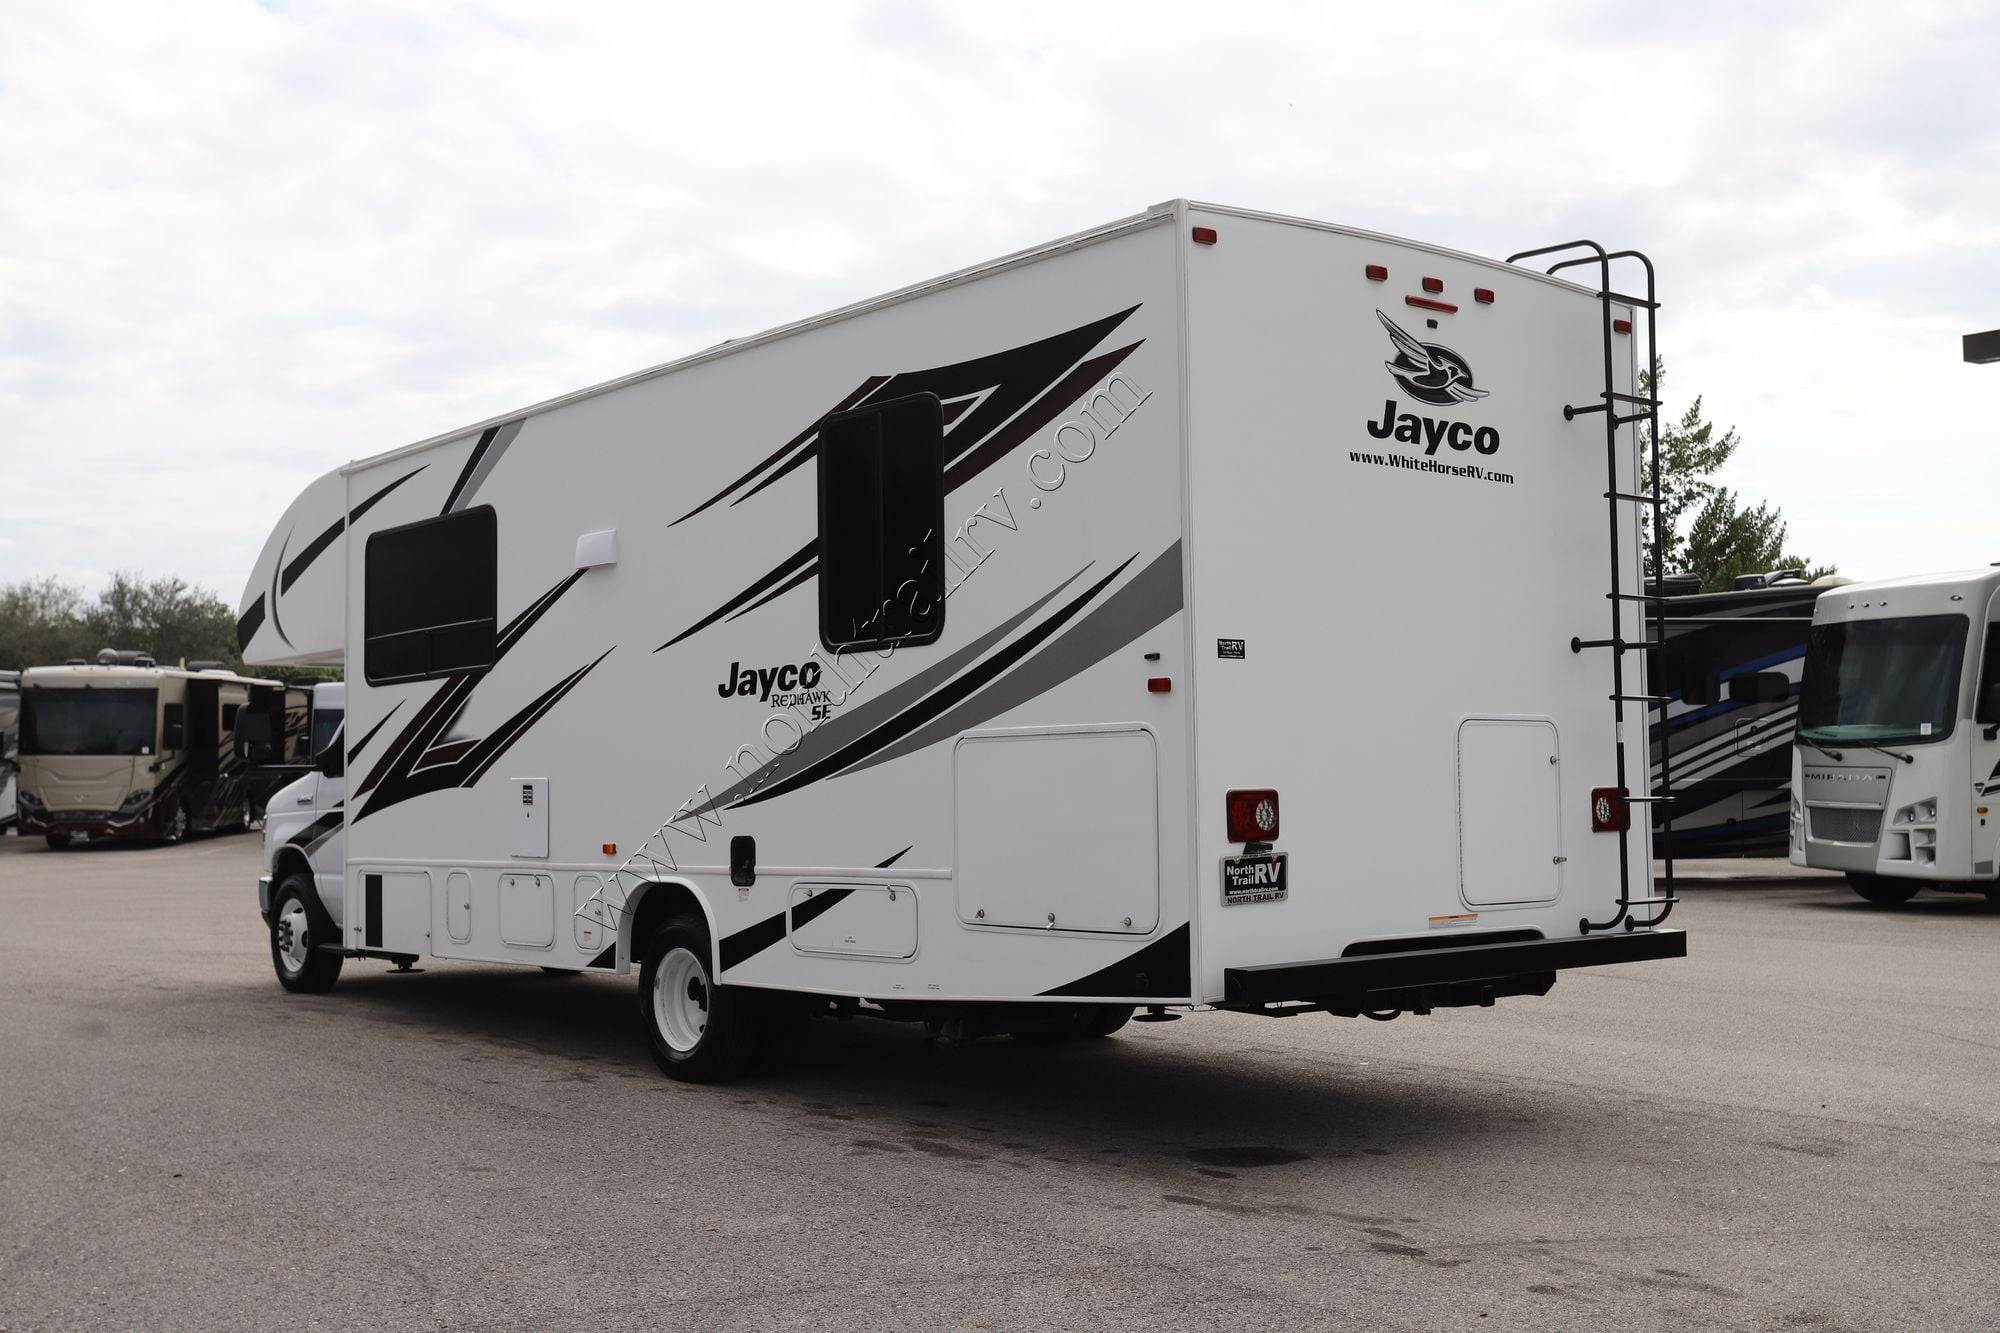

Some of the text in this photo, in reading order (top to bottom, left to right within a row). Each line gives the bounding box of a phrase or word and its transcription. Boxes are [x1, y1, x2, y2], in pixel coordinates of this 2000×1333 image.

[1366, 399, 1500, 456] Jayco
[1349, 451, 1514, 484] www.WhiteHorseRV.com
[1231, 641, 1244, 651] RV
[718, 661, 821, 702] Jayco
[811, 704, 832, 721] SE
[1810, 773, 1873, 781] MIRADA
[1226, 865, 1254, 876] North
[1254, 862, 1281, 884] RV
[1231, 875, 1254, 886] Trail
[1227, 895, 1251, 904] NORTH
[1252, 892, 1273, 902] TRAIL
